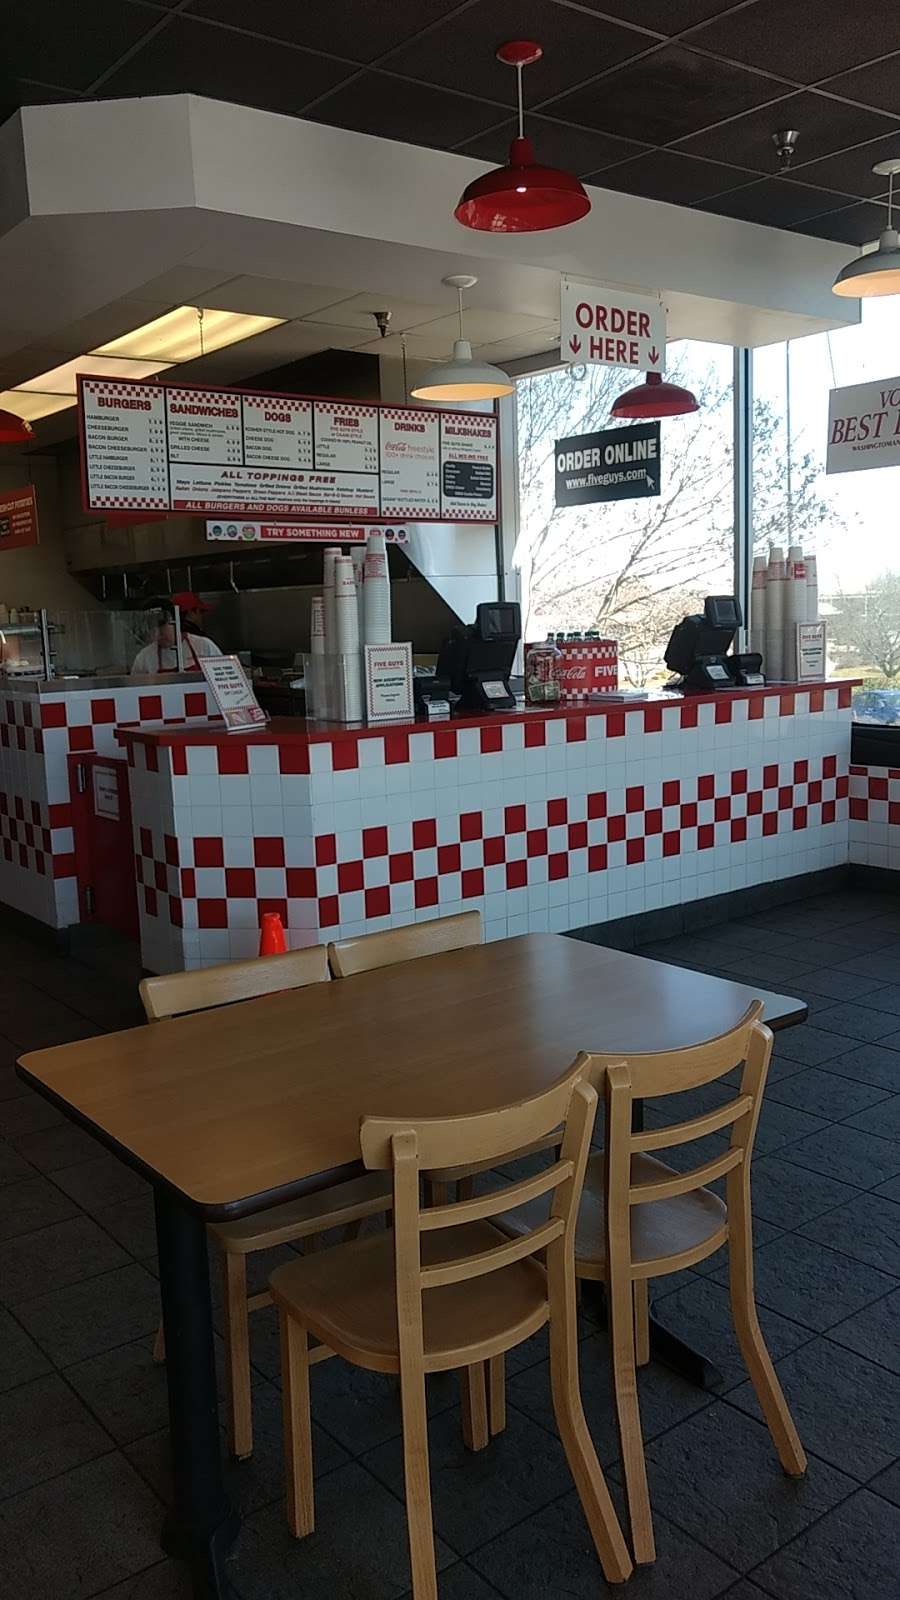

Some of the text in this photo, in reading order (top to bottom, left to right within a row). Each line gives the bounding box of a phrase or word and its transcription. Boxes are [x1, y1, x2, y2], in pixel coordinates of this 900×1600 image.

[576, 302, 650, 338] ORDER
[590, 335, 638, 364] HERE
[98, 397, 152, 410] BURGERS
[170, 403, 238, 418] SANDWICHES
[264, 412, 292, 422] DOGS
[334, 417, 359, 427] FRIES
[394, 422, 426, 433] DRINKS
[830, 412, 888, 444] BEST
[445, 426, 492, 438] MILKSHAKES
[557, 438, 657, 473] ORDER ONLINE
[221, 471, 336, 483] ALL TOPPINGS FREE
[566, 468, 647, 490] www.fiveguys.com
[205, 502, 245, 510] BURGERS
[290, 505, 332, 513] AVAILABLE
[334, 507, 368, 515] BUNLESS
[267, 528, 359, 538] TRY SOMETHING NEW
[594, 664, 618, 677] FIVE
